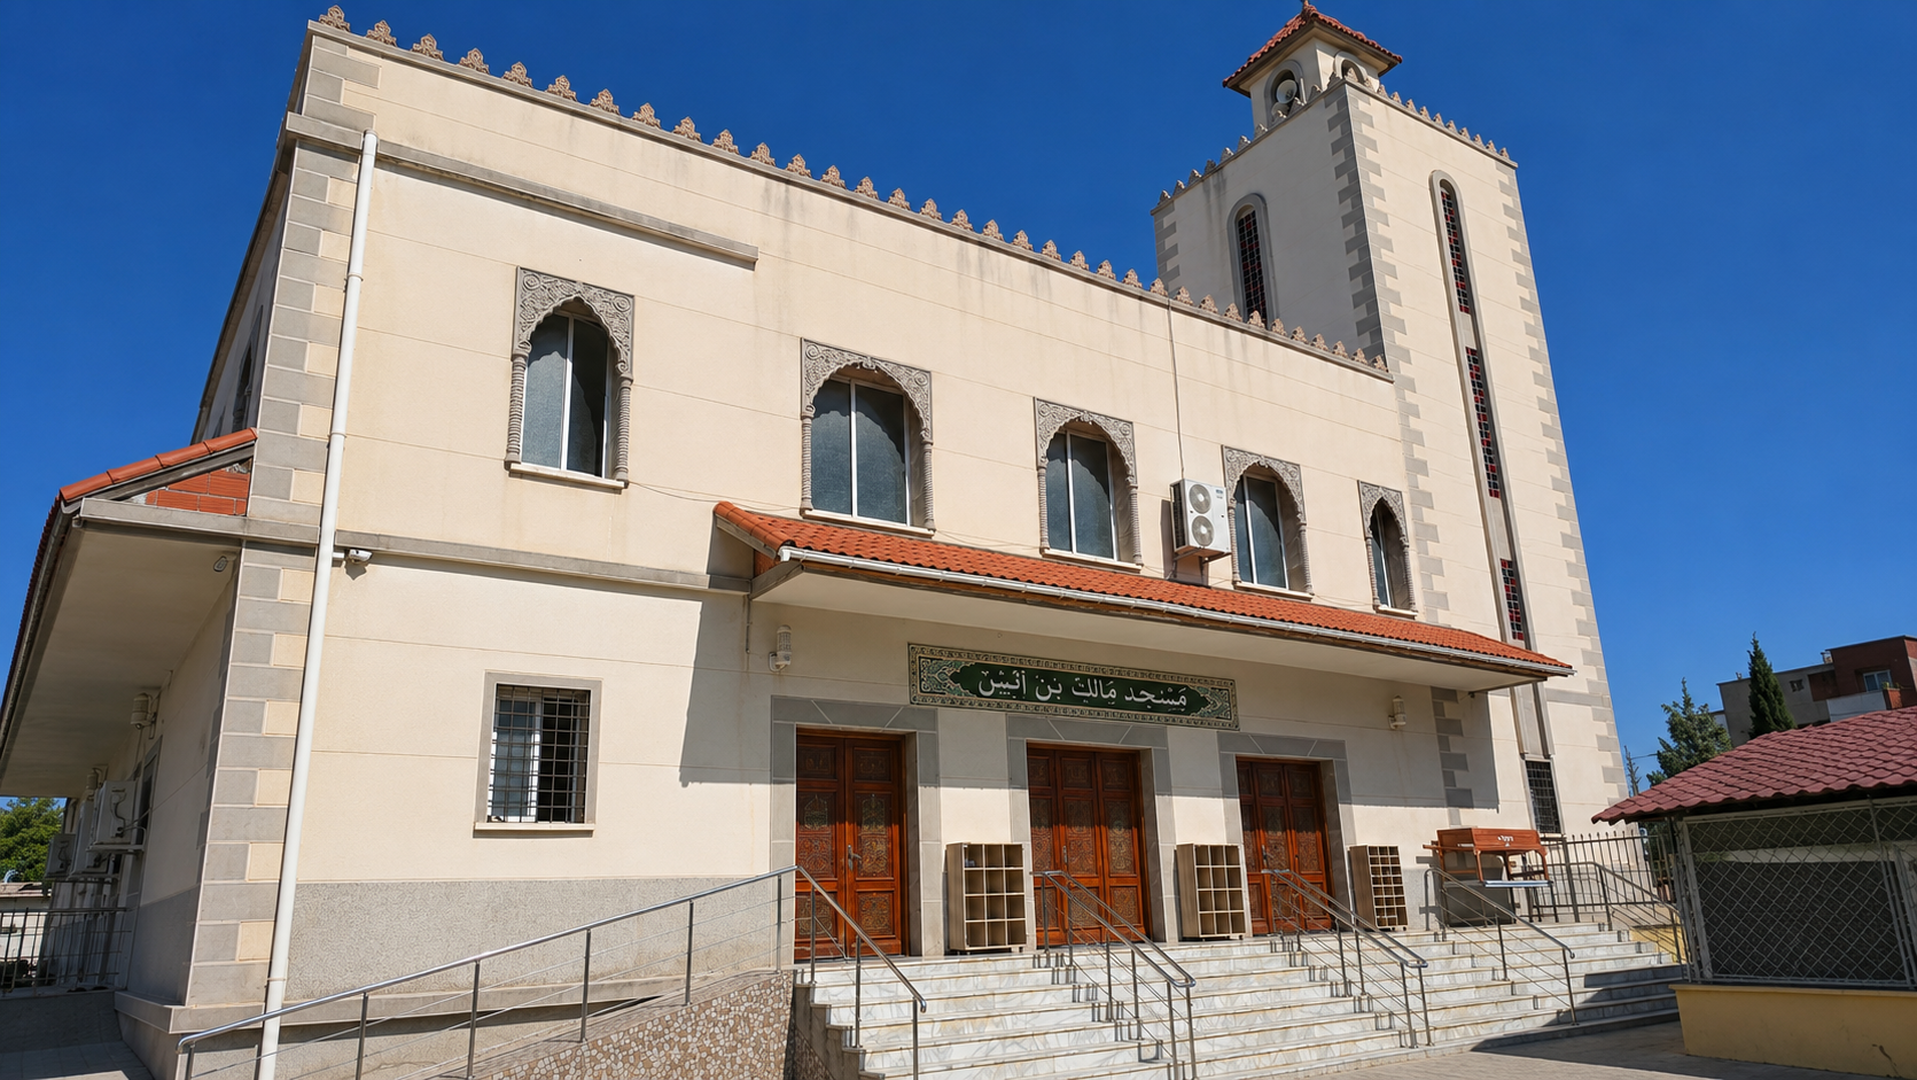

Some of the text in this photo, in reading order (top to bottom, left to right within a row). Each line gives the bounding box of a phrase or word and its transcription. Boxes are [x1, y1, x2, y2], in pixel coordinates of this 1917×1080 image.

[1035, 675, 1063, 702] بن
[1072, 678, 1117, 705] مالك
[1124, 687, 1187, 712] مسجد
